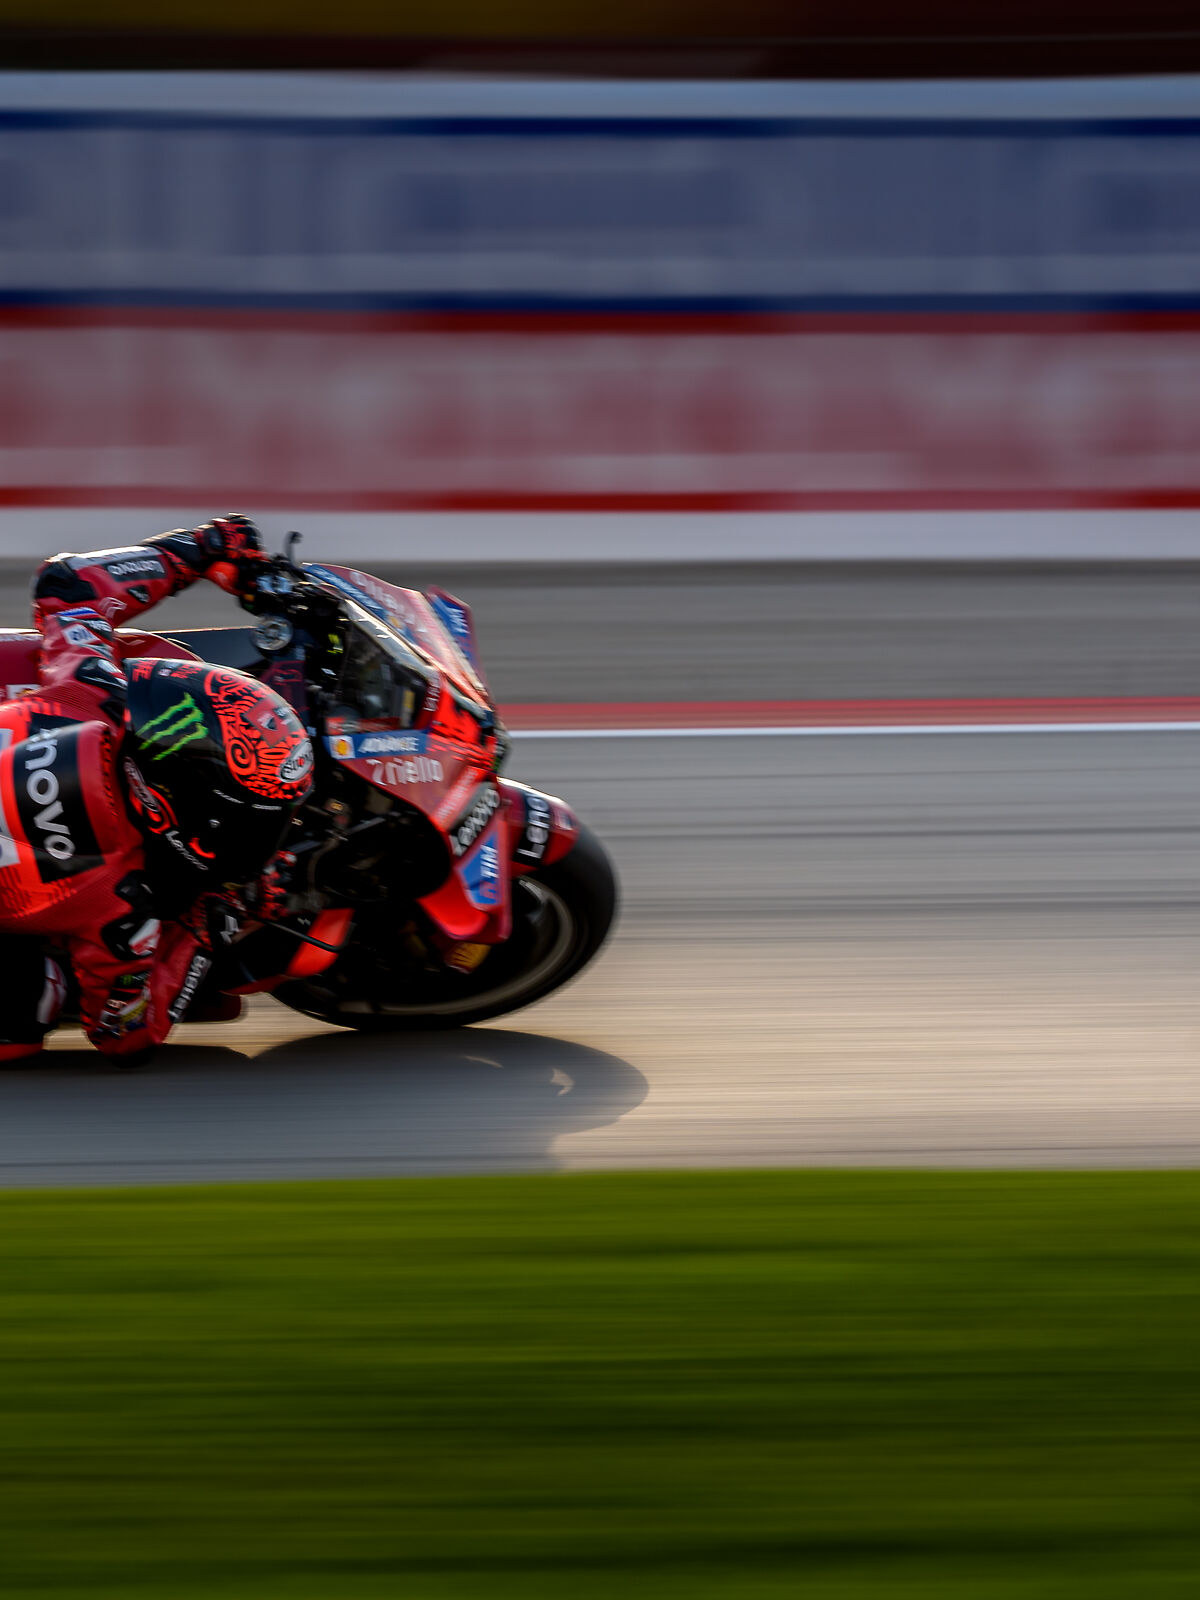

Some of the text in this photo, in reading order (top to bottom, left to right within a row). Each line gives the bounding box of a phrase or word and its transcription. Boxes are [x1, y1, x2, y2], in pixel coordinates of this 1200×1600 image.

[385, 757, 444, 786] riello
[25, 732, 77, 860] novo
[451, 782, 499, 857] Lenovo
[164, 830, 208, 871] Lenovo
[480, 844, 499, 878] TIM
